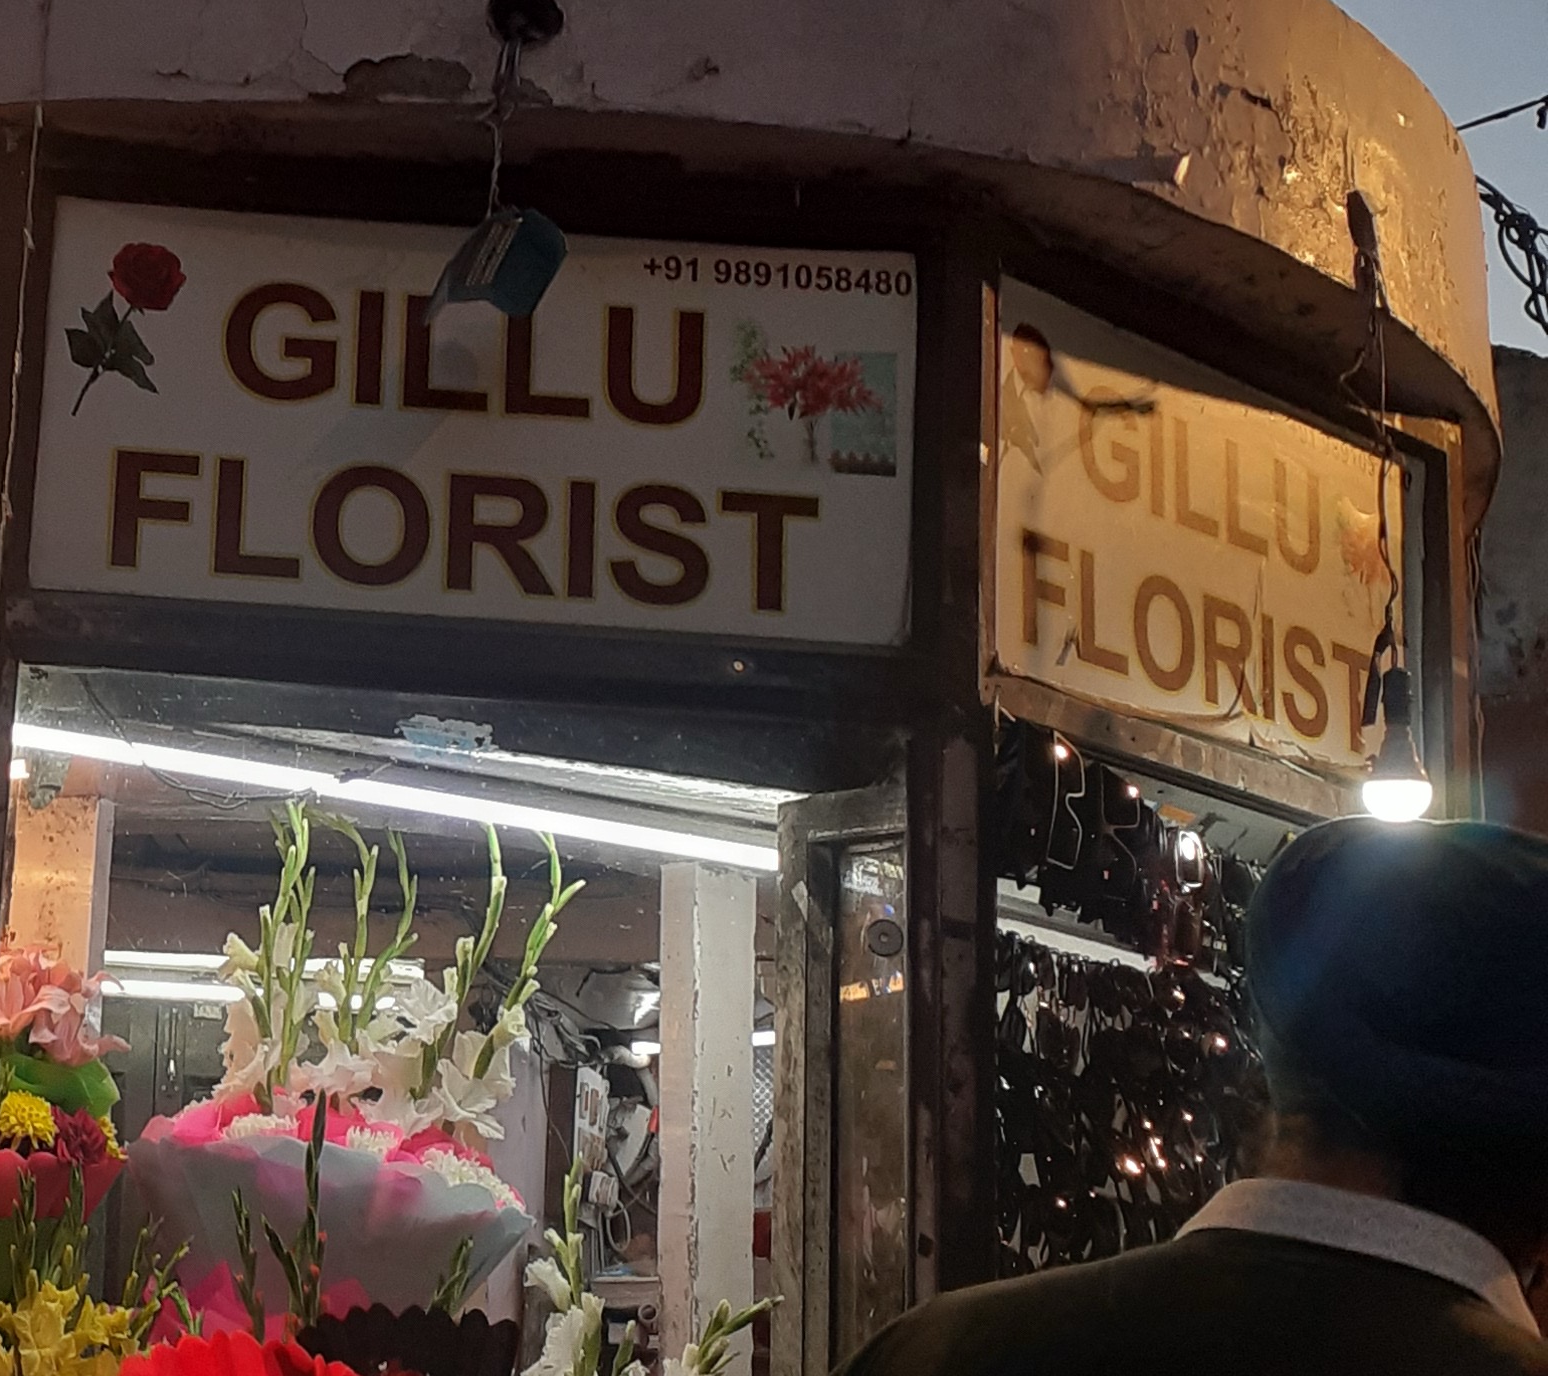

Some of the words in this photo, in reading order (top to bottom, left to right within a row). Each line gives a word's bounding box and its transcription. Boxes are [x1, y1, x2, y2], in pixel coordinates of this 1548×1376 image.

[222, 281, 707, 425] GILLU
[643, 255, 700, 283] +91
[713, 258, 913, 297] 9891058480
[108, 447, 821, 614] FLORIST
[1077, 385, 1322, 575] GILLU
[1021, 527, 1374, 756] FLORIST
